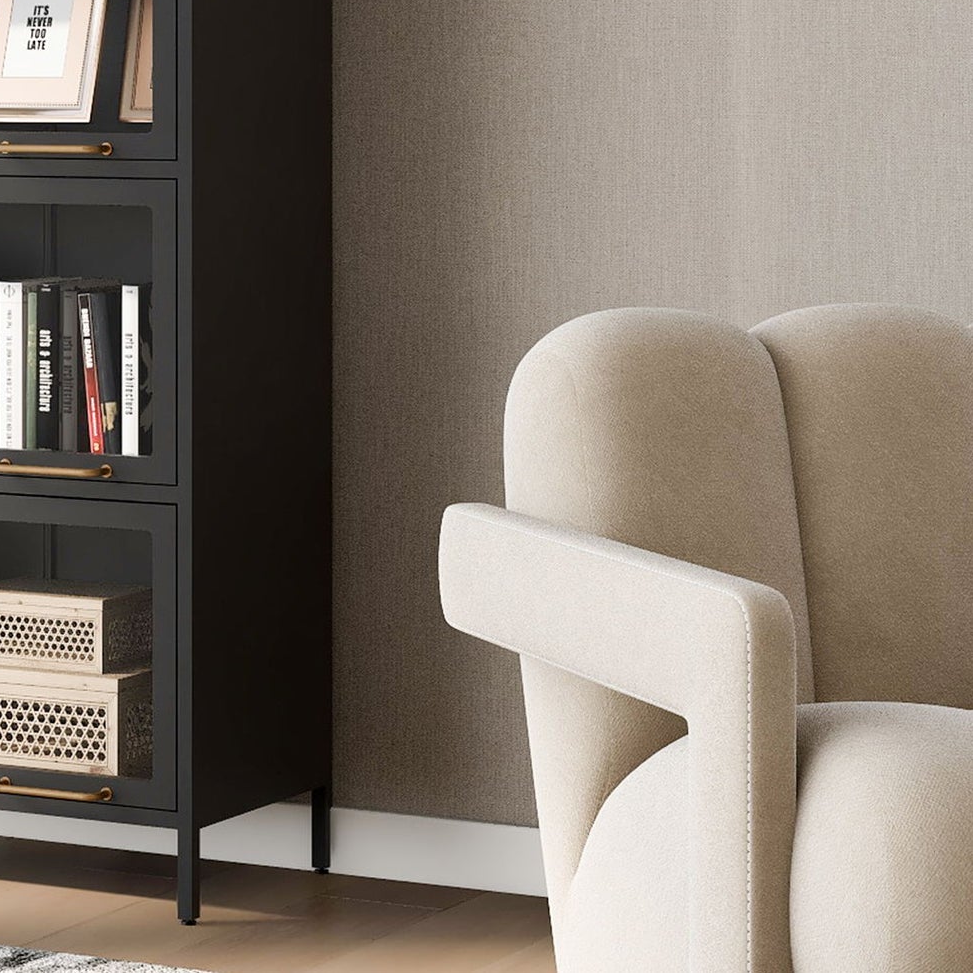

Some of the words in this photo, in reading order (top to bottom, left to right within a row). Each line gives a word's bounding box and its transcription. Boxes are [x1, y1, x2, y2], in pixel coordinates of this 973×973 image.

[33, 5, 49, 15] IT'S
[27, 16, 53, 27] NEVER
[30, 28, 47, 39] TOO
[27, 40, 46, 50] LATE
[39, 329, 53, 348] arts
[125, 333, 134, 349] arts
[39, 360, 54, 412] architecture
[125, 364, 135, 415] architecture
